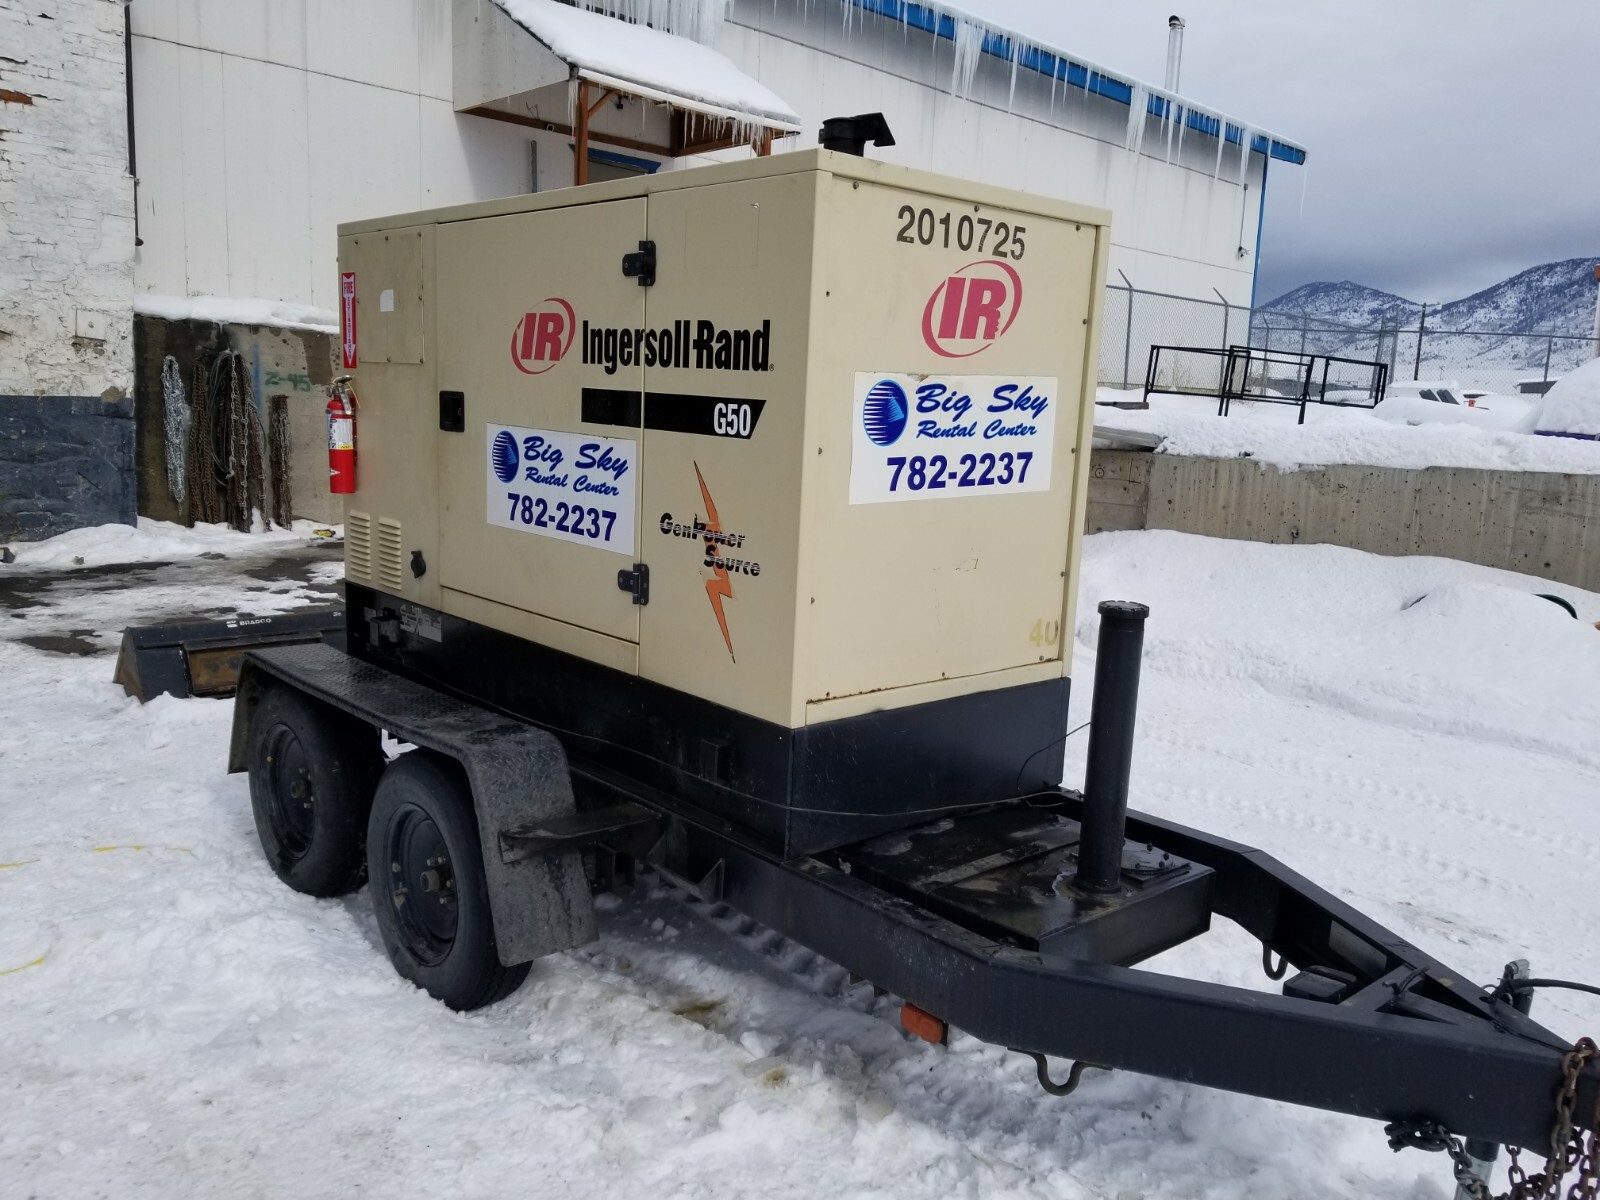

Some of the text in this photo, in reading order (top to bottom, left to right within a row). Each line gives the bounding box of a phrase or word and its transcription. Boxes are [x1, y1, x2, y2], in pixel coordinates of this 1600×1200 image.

[896, 205, 1026, 260] 2010725
[344, 282, 353, 294] FIRE
[937, 276, 1007, 340] IR
[520, 312, 565, 361] IR
[713, 402, 751, 436] G50
[915, 383, 1048, 422] Big Sky
[915, 418, 1037, 440] Rental Center
[523, 436, 629, 481] Big Sky
[886, 451, 1033, 492] 782-2237
[525, 466, 619, 497] Rental Center
[507, 492, 617, 541] 782-2237
[703, 544, 760, 576] Source
